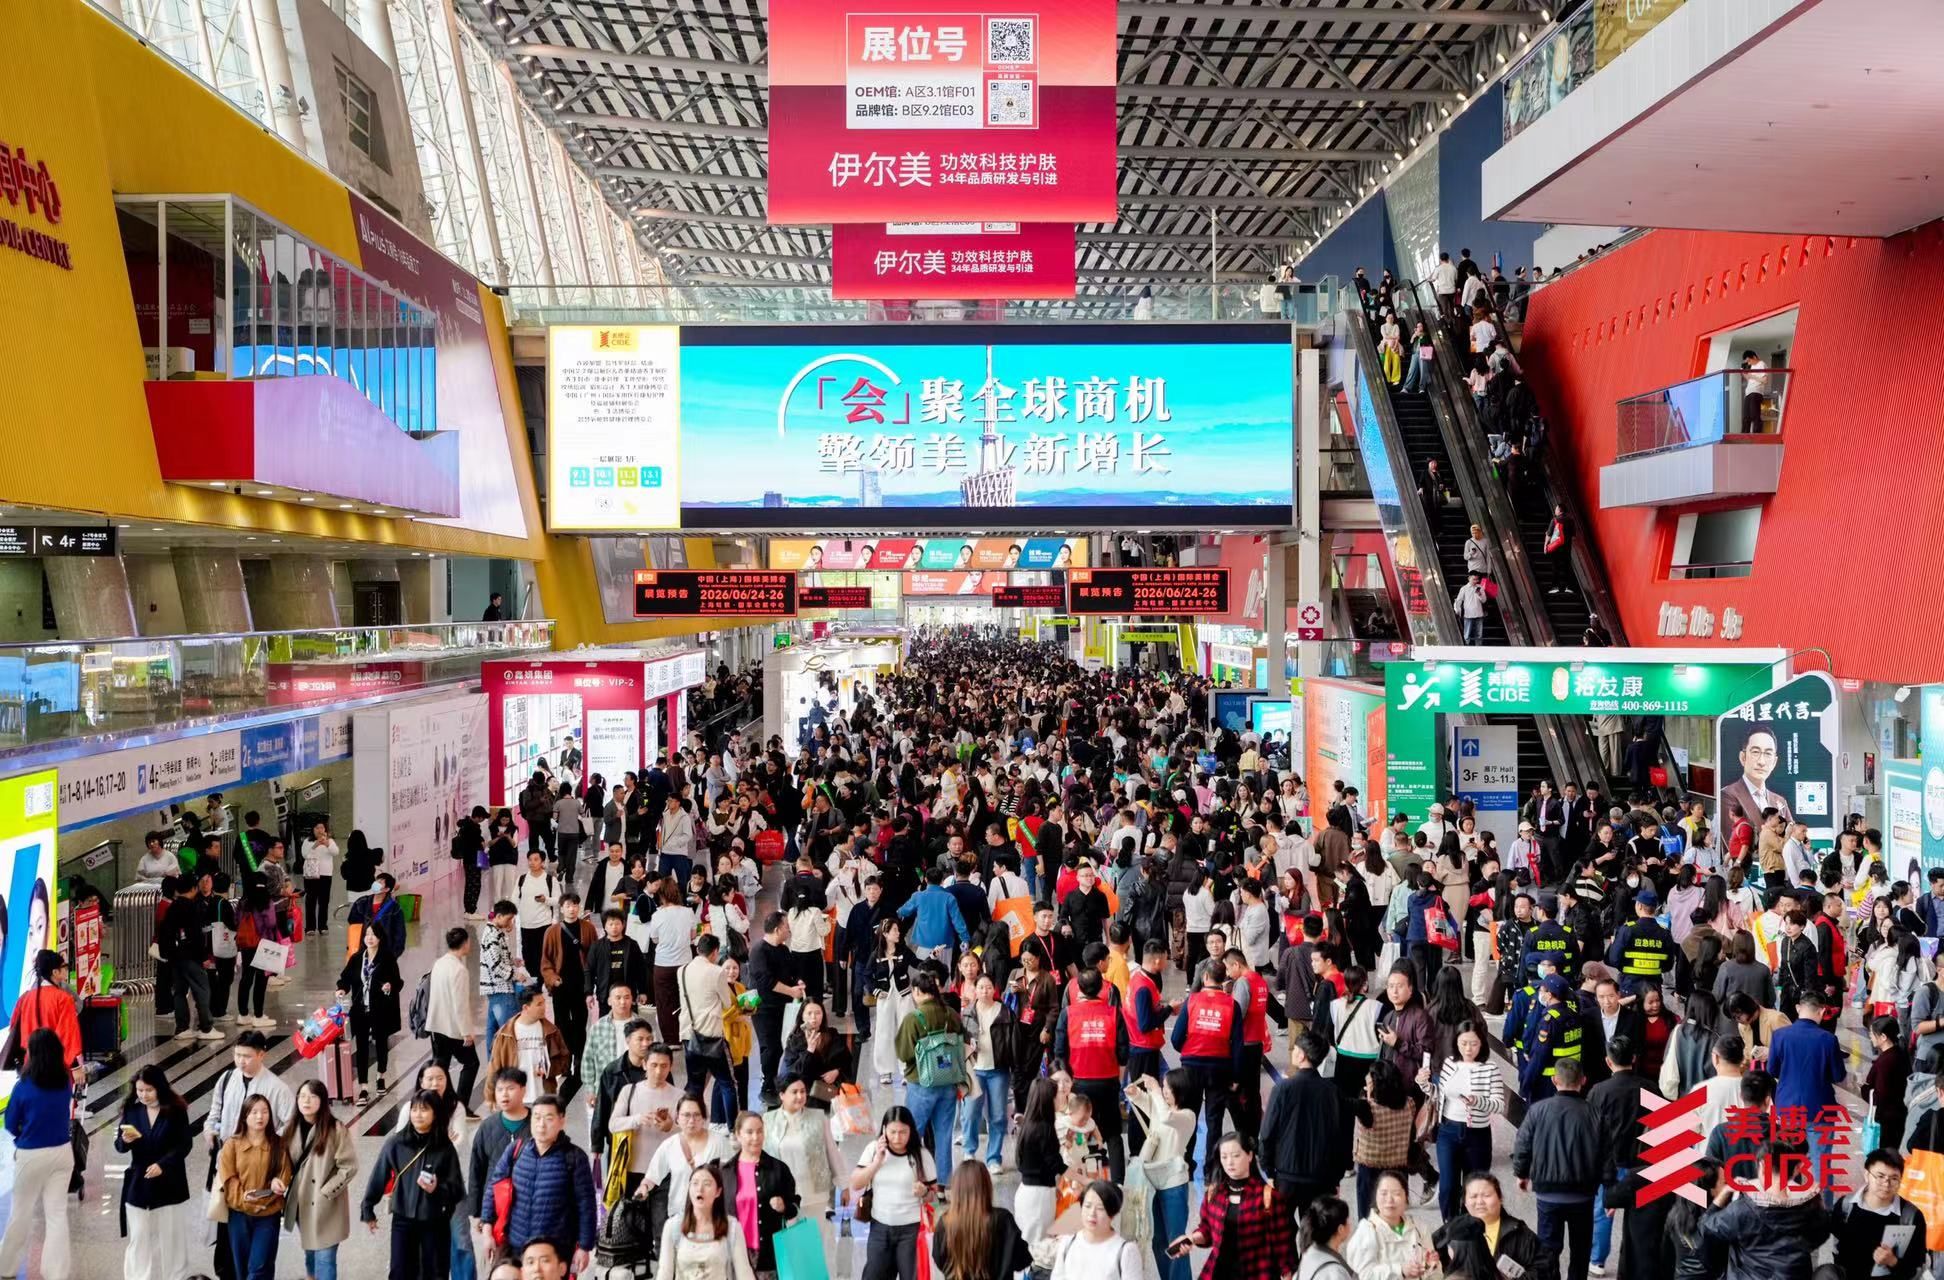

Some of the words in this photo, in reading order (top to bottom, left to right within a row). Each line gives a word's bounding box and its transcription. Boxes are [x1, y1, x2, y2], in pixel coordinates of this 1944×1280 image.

[861, 25, 967, 62] 展位号
[905, 86, 976, 98] A区3.1馆F01
[902, 104, 974, 117] B区9.2馆E03
[940, 153, 1057, 171] 功效科技护肤
[828, 152, 932, 188] 伊尔美
[939, 172, 1058, 186] 34年品质研发与引进
[874, 250, 946, 275] 伊尔美
[951, 251, 1033, 263] 功效科技护肤
[951, 264, 1034, 273] 34年品质研发与引进
[817, 375, 1171, 425] 「会」聚全球商机
[817, 433, 1172, 476] 擎领美业新增长
[60, 535, 76, 547] 4F
[700, 590, 784, 600] 2026/06/24-26
[1134, 587, 1217, 598] 2026/06/24-26
[609, 678, 634, 687] VIP-2
[1487, 688, 1531, 702] CIBE
[1621, 701, 1688, 711] 400-869-1115
[1740, 701, 1810, 722] 明星代言
[1463, 769, 1478, 781] 3F
[1484, 775, 1516, 784] 9.3-11.3
[67, 771, 126, 804] 1-8,14-16,17-20
[1537, 940, 1566, 950] 应急机动
[1634, 938, 1663, 948] 应急机动
